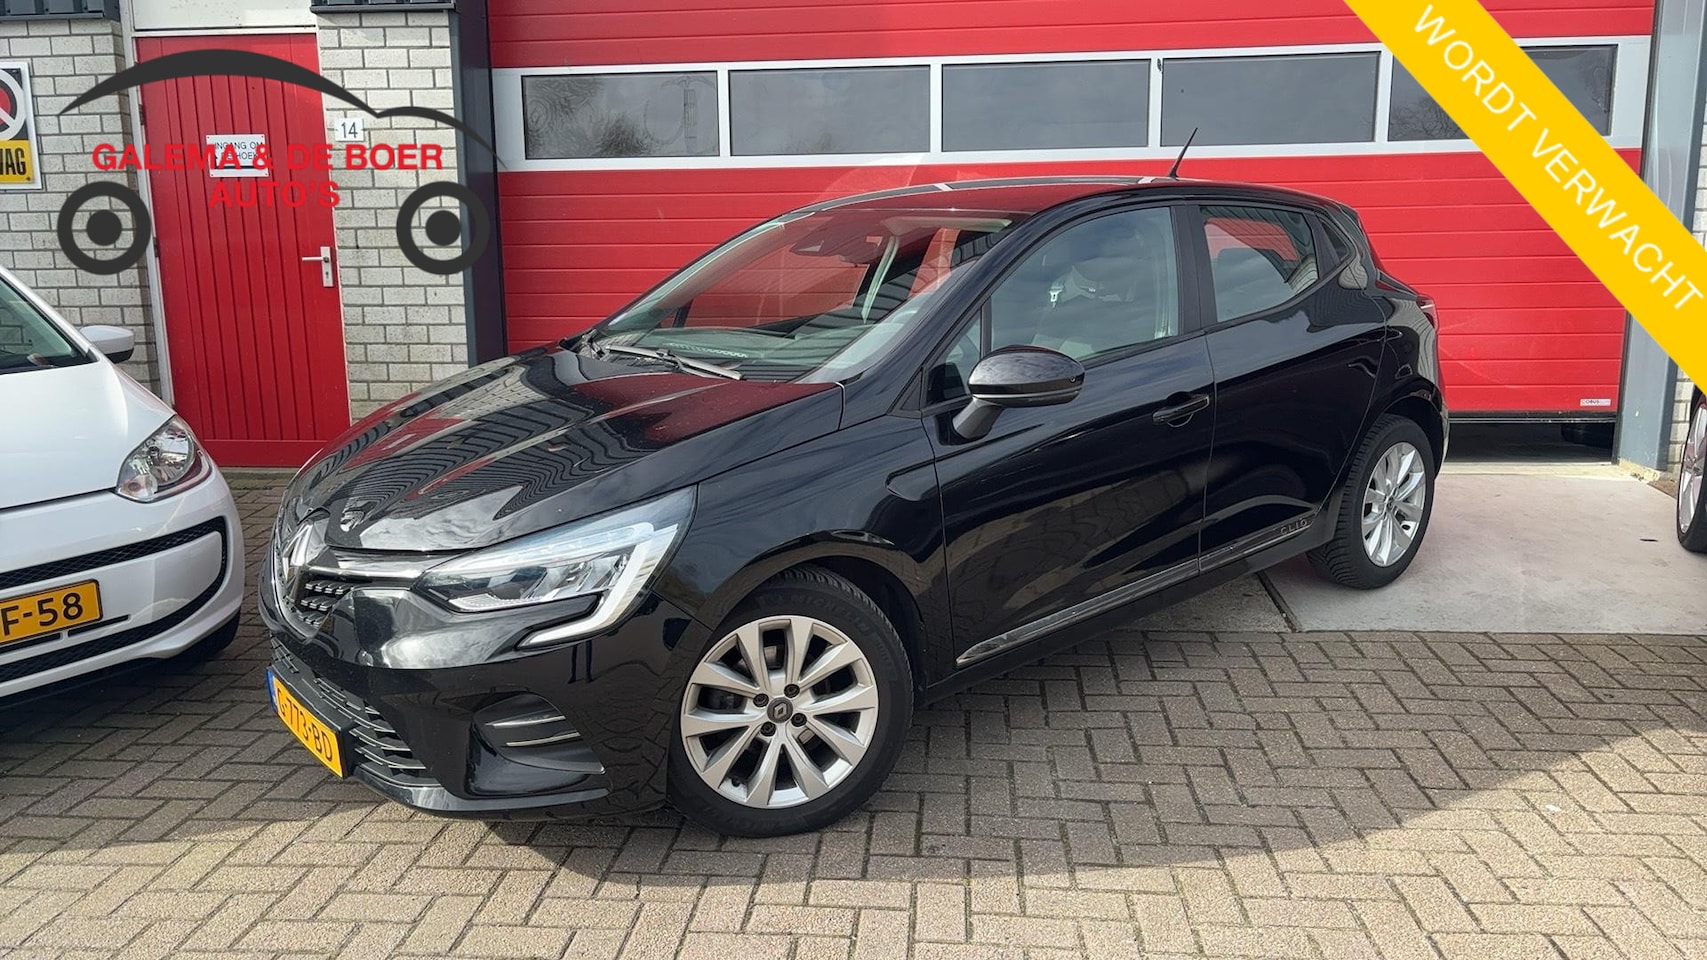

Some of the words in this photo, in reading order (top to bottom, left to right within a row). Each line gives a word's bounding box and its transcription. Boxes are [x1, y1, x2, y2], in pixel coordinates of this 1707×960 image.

[341, 122, 358, 138] 14
[0, 148, 26, 175] AG
[1280, 518, 1308, 535] CLIO
